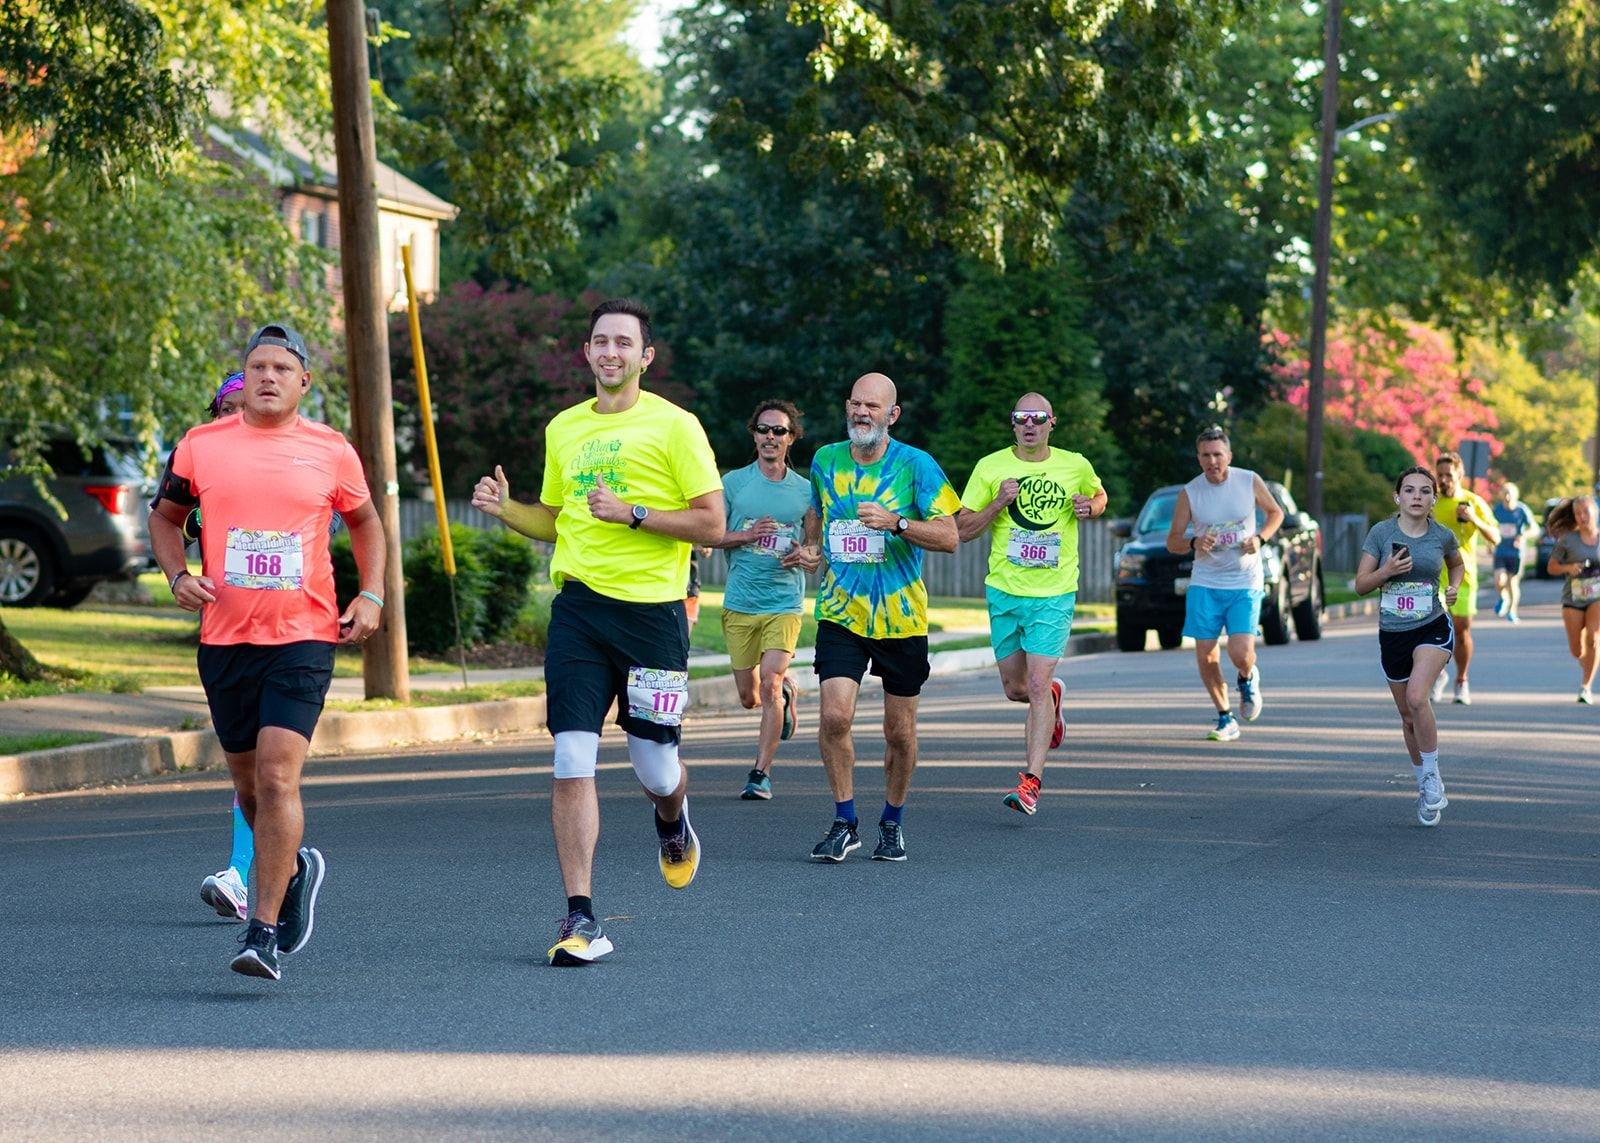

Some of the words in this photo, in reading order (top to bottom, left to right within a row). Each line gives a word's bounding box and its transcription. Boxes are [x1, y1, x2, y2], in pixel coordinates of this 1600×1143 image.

[1019, 479, 1066, 496] MOON
[1019, 494, 1067, 510] LIGHT
[841, 536, 867, 553] 150
[1020, 544, 1047, 560] 366
[245, 553, 282, 576] 168
[1397, 596, 1415, 610] 96
[652, 691, 679, 713] 117
